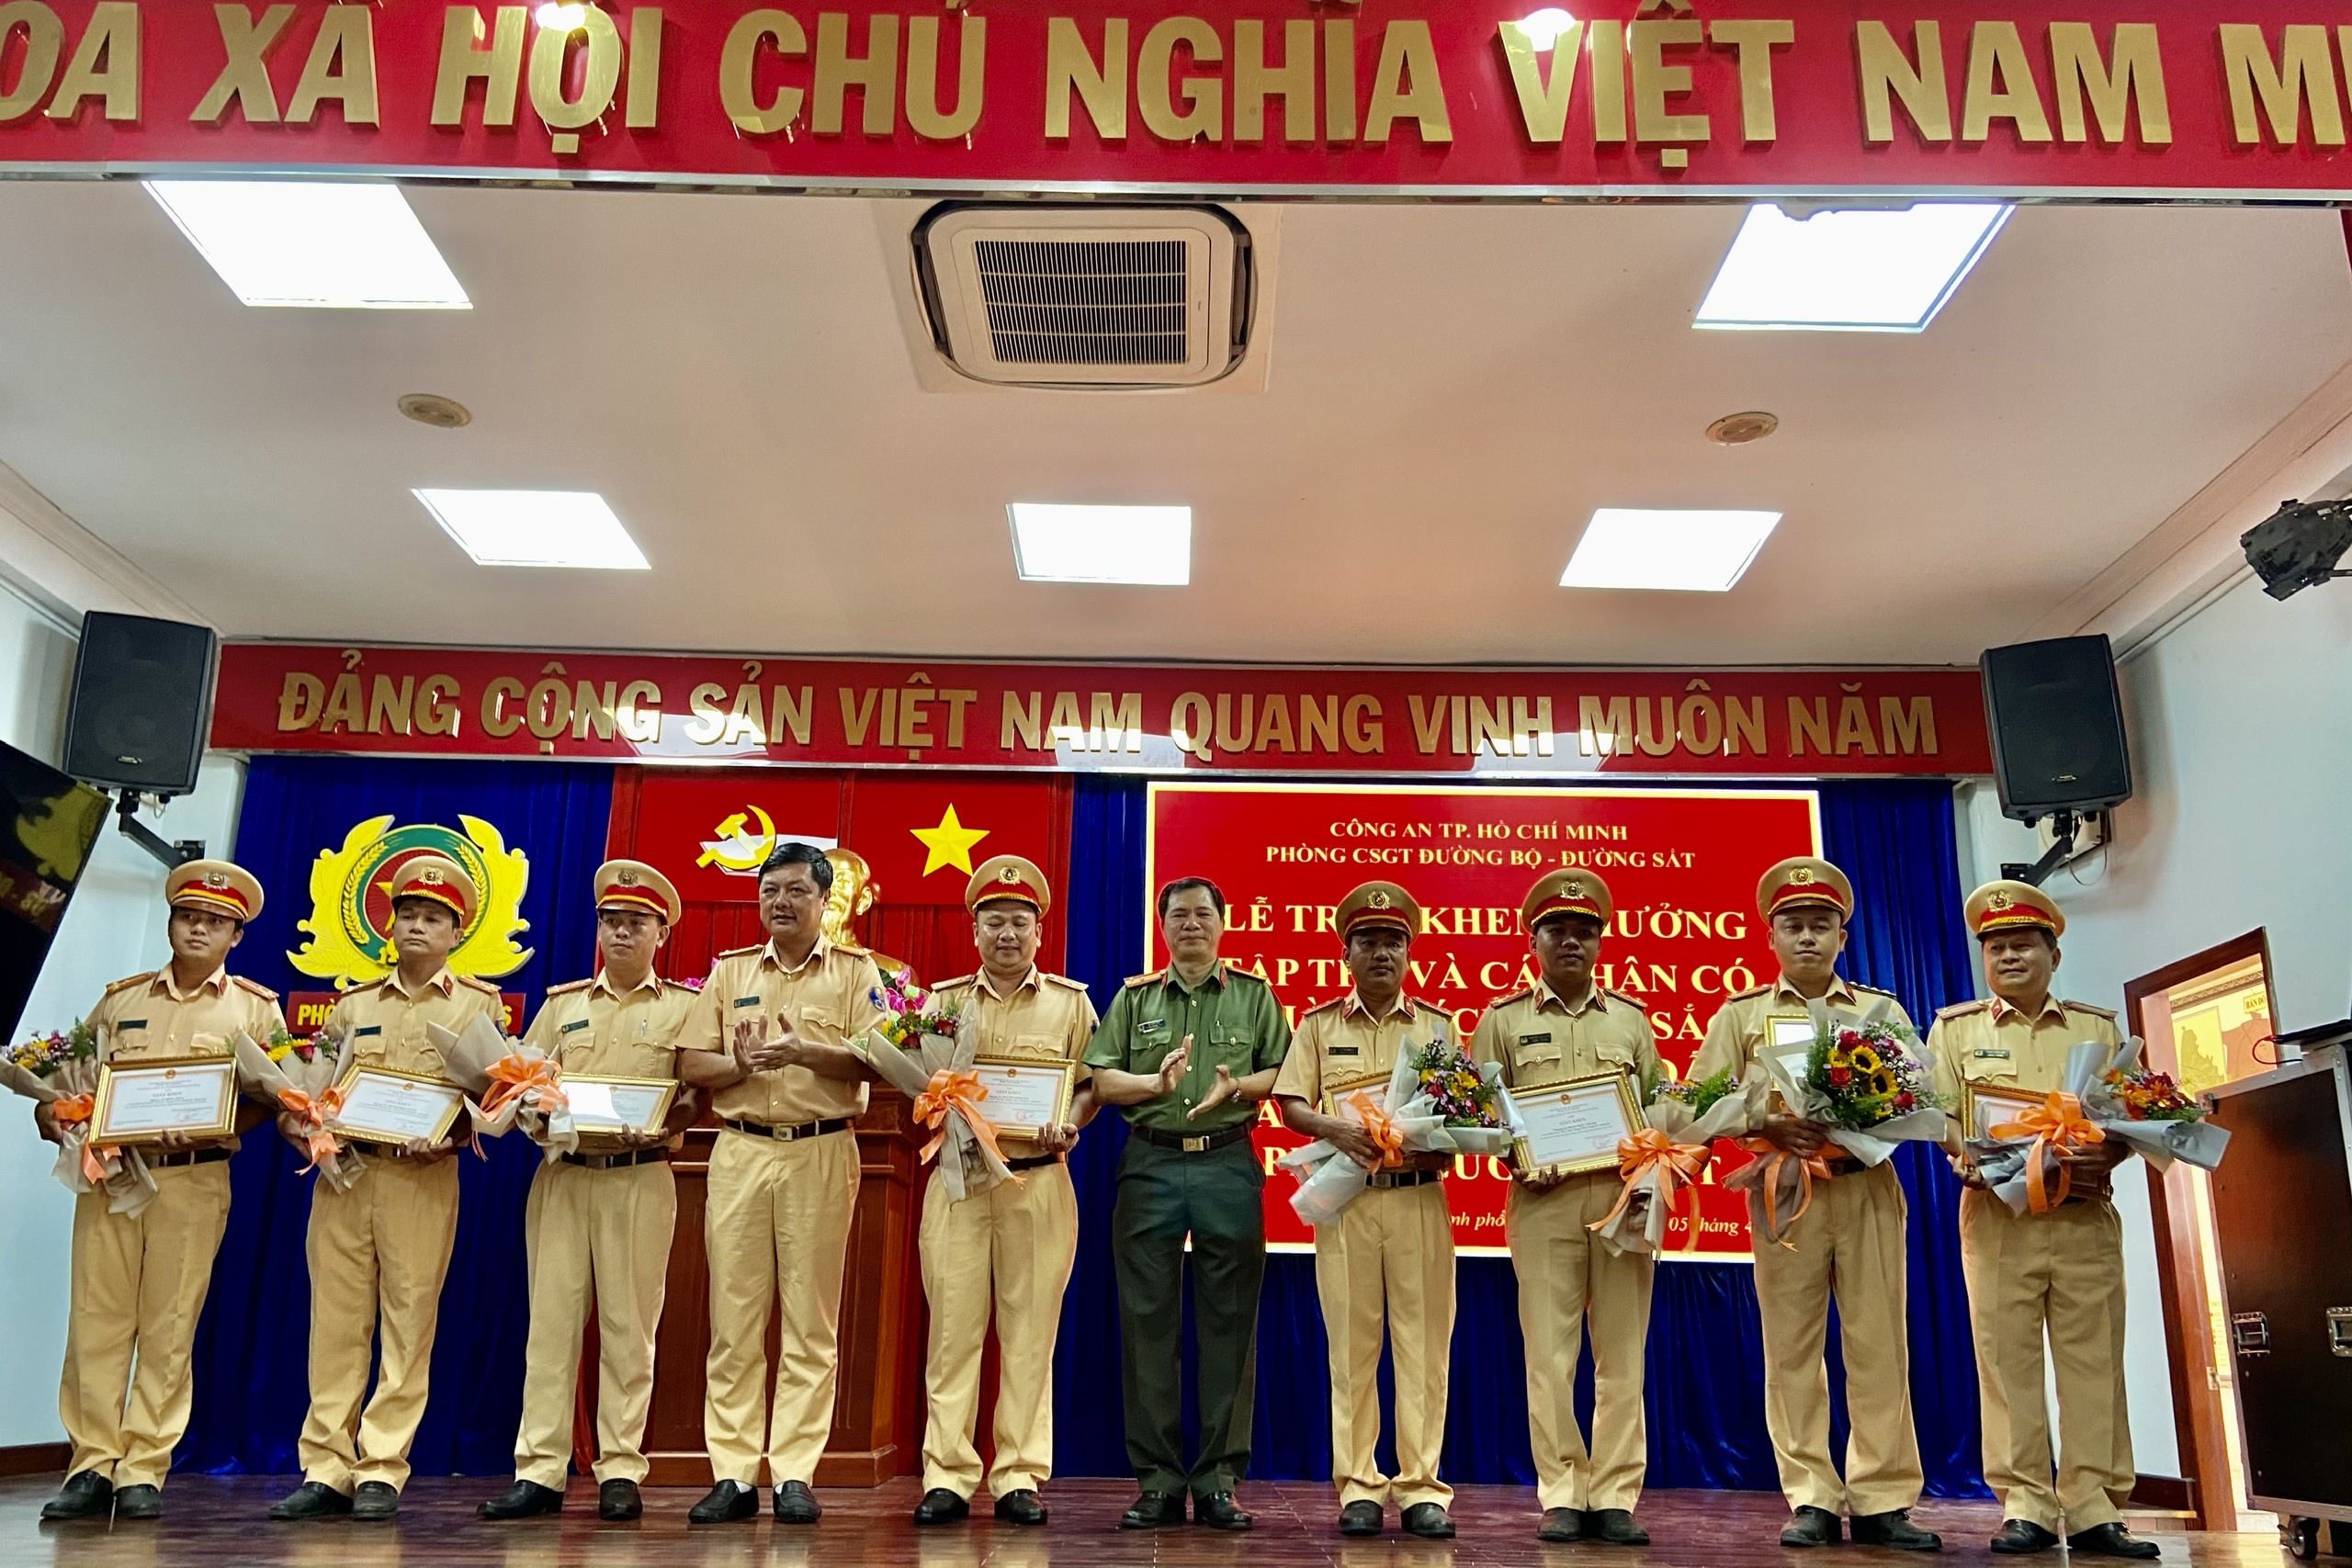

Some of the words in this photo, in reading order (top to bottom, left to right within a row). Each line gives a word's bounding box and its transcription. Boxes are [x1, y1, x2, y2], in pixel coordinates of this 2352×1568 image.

[1498, 0, 1794, 168] VIỆT
[1855, 19, 2173, 145] NAM
[277, 649, 461, 738] ĐẢNG
[481, 661, 663, 754] CỘNG
[684, 660, 813, 747] SẢN
[838, 671, 978, 761] VIỆT
[1001, 690, 1143, 754] NAM
[1170, 691, 1384, 762] QUANG
[1408, 694, 1554, 758] VINH
[1578, 678, 1768, 758] MUÔN
[1788, 682, 1939, 756] NĂM
[1329, 818, 1396, 838] CÔNG
[1401, 823, 1432, 838] AN
[1438, 823, 1472, 840] TP.
[1476, 819, 1511, 840] HỒ
[1516, 820, 1559, 840] CHÍ
[1565, 824, 1628, 840] MINH
[1265, 842, 1347, 863] PHÒNG
[1351, 847, 1414, 864] CSGT
[1418, 844, 1504, 866] ĐƯỜNG
[1510, 847, 1543, 870] BỘ
[1561, 846, 1646, 868] ĐƯỜNG
[1225, 897, 1274, 932] LỄ
[1285, 904, 1337, 933] TR
[1600, 902, 1747, 940] ƯỞNG
[1410, 953, 1468, 990] VÀ
[1479, 953, 1537, 990] CÁ
[1590, 955, 1678, 993] HÂN
[1690, 957, 1756, 995] CÓ
[297, 998, 336, 1026] PHÒ
[1474, 1209, 1506, 1231] phố
[1668, 1217, 1689, 1232] 05
[1699, 1217, 1739, 1236] háng
